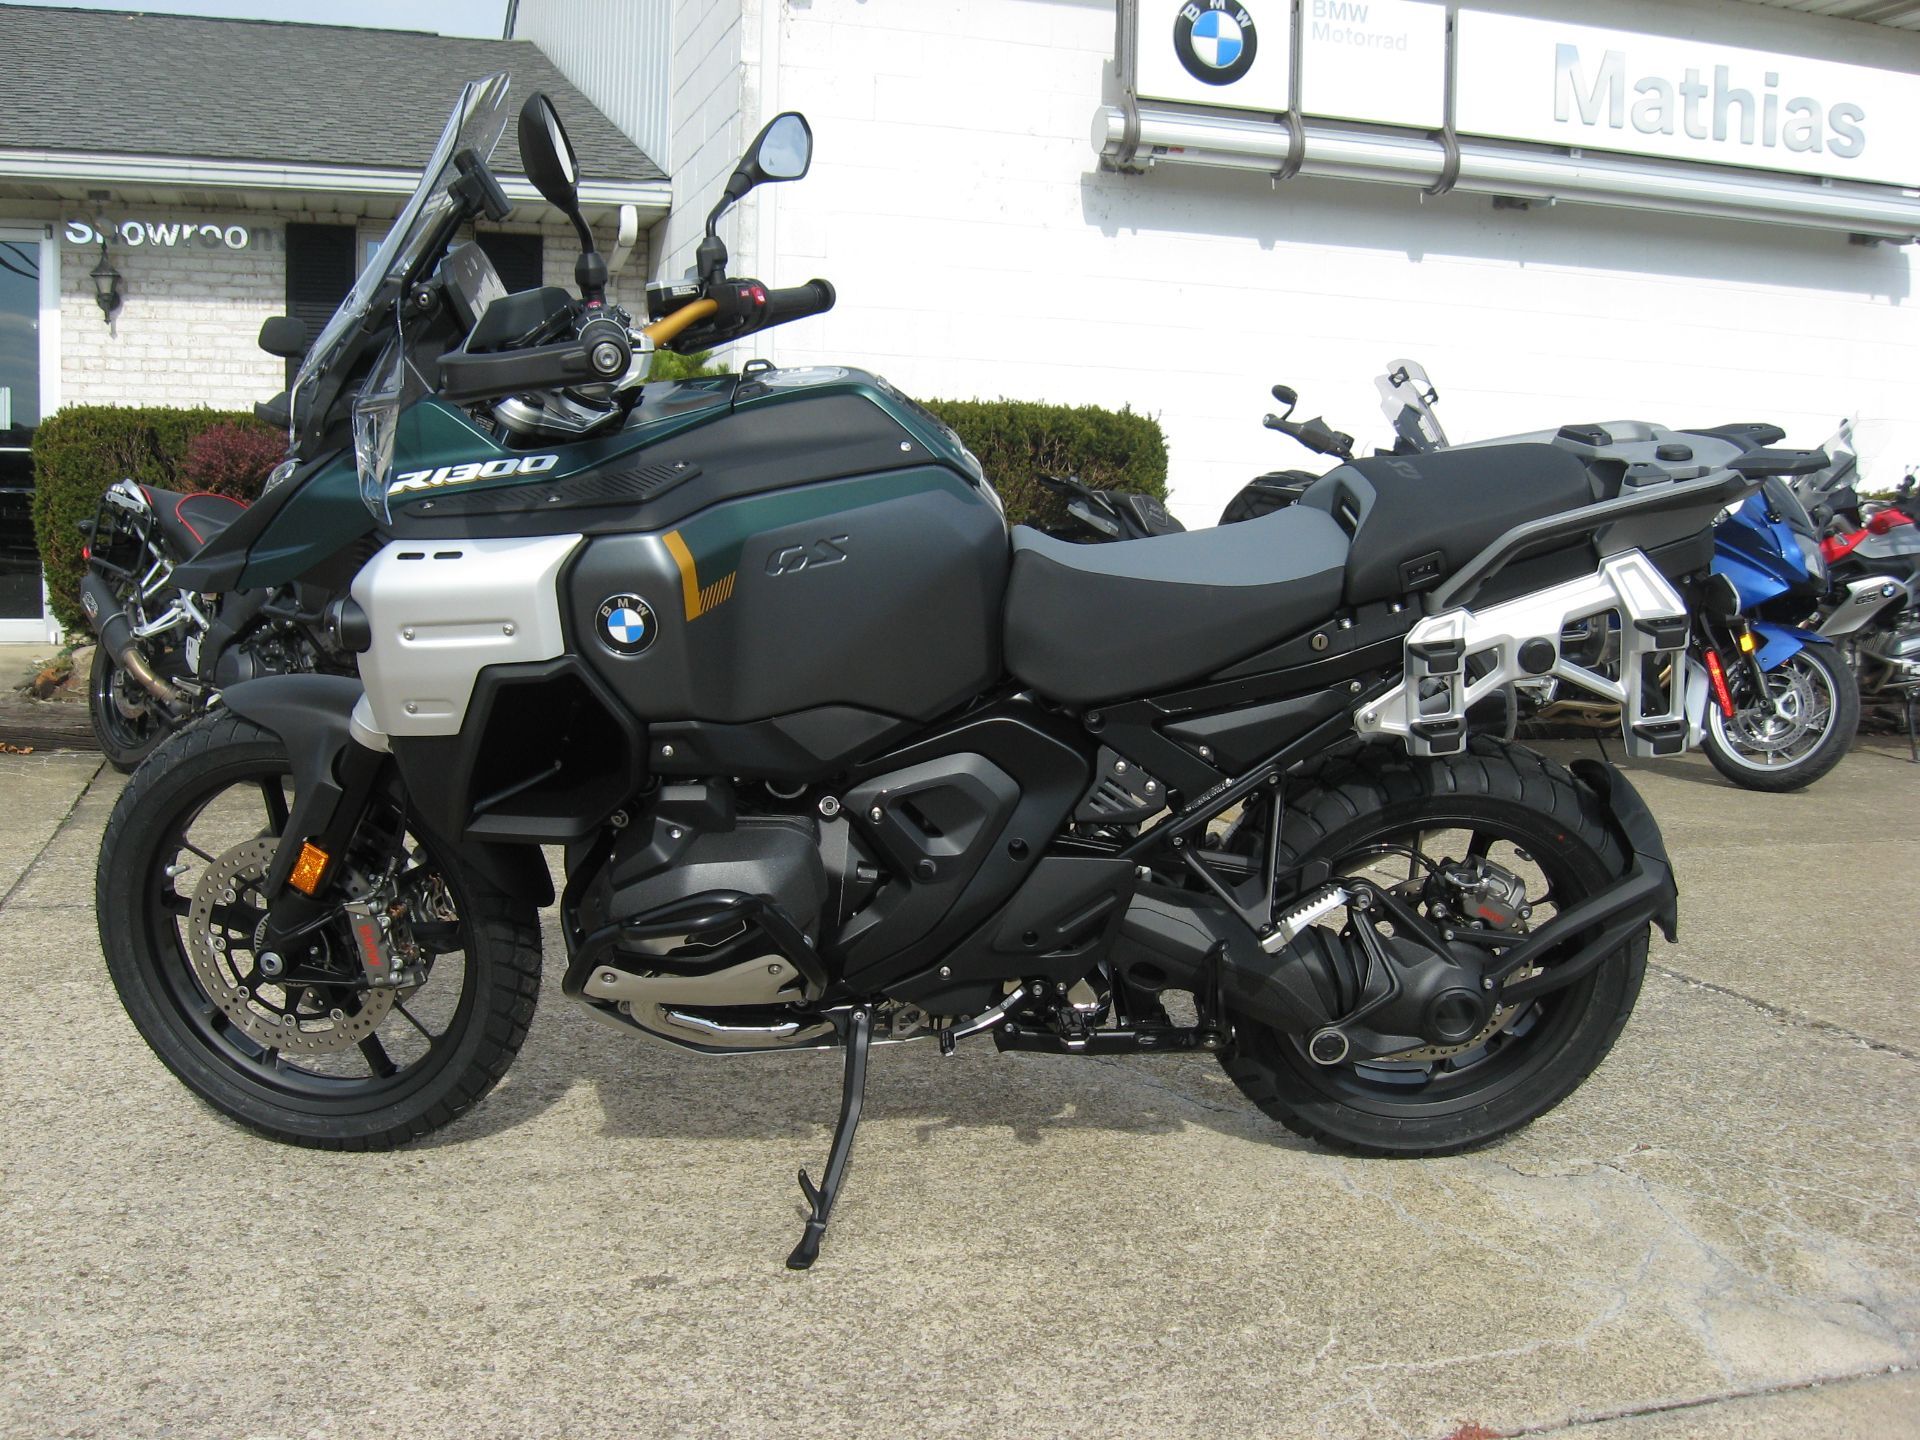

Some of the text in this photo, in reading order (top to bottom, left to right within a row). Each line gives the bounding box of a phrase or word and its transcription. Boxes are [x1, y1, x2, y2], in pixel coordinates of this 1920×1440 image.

[1182, 0, 1253, 28] BMW
[1312, 0, 1369, 23] BMW
[1311, 21, 1408, 51] Motorrad
[1553, 42, 1866, 159] Mathias
[386, 454, 560, 496] R1300
[765, 534, 849, 577] GS
[600, 597, 650, 618] BMW
